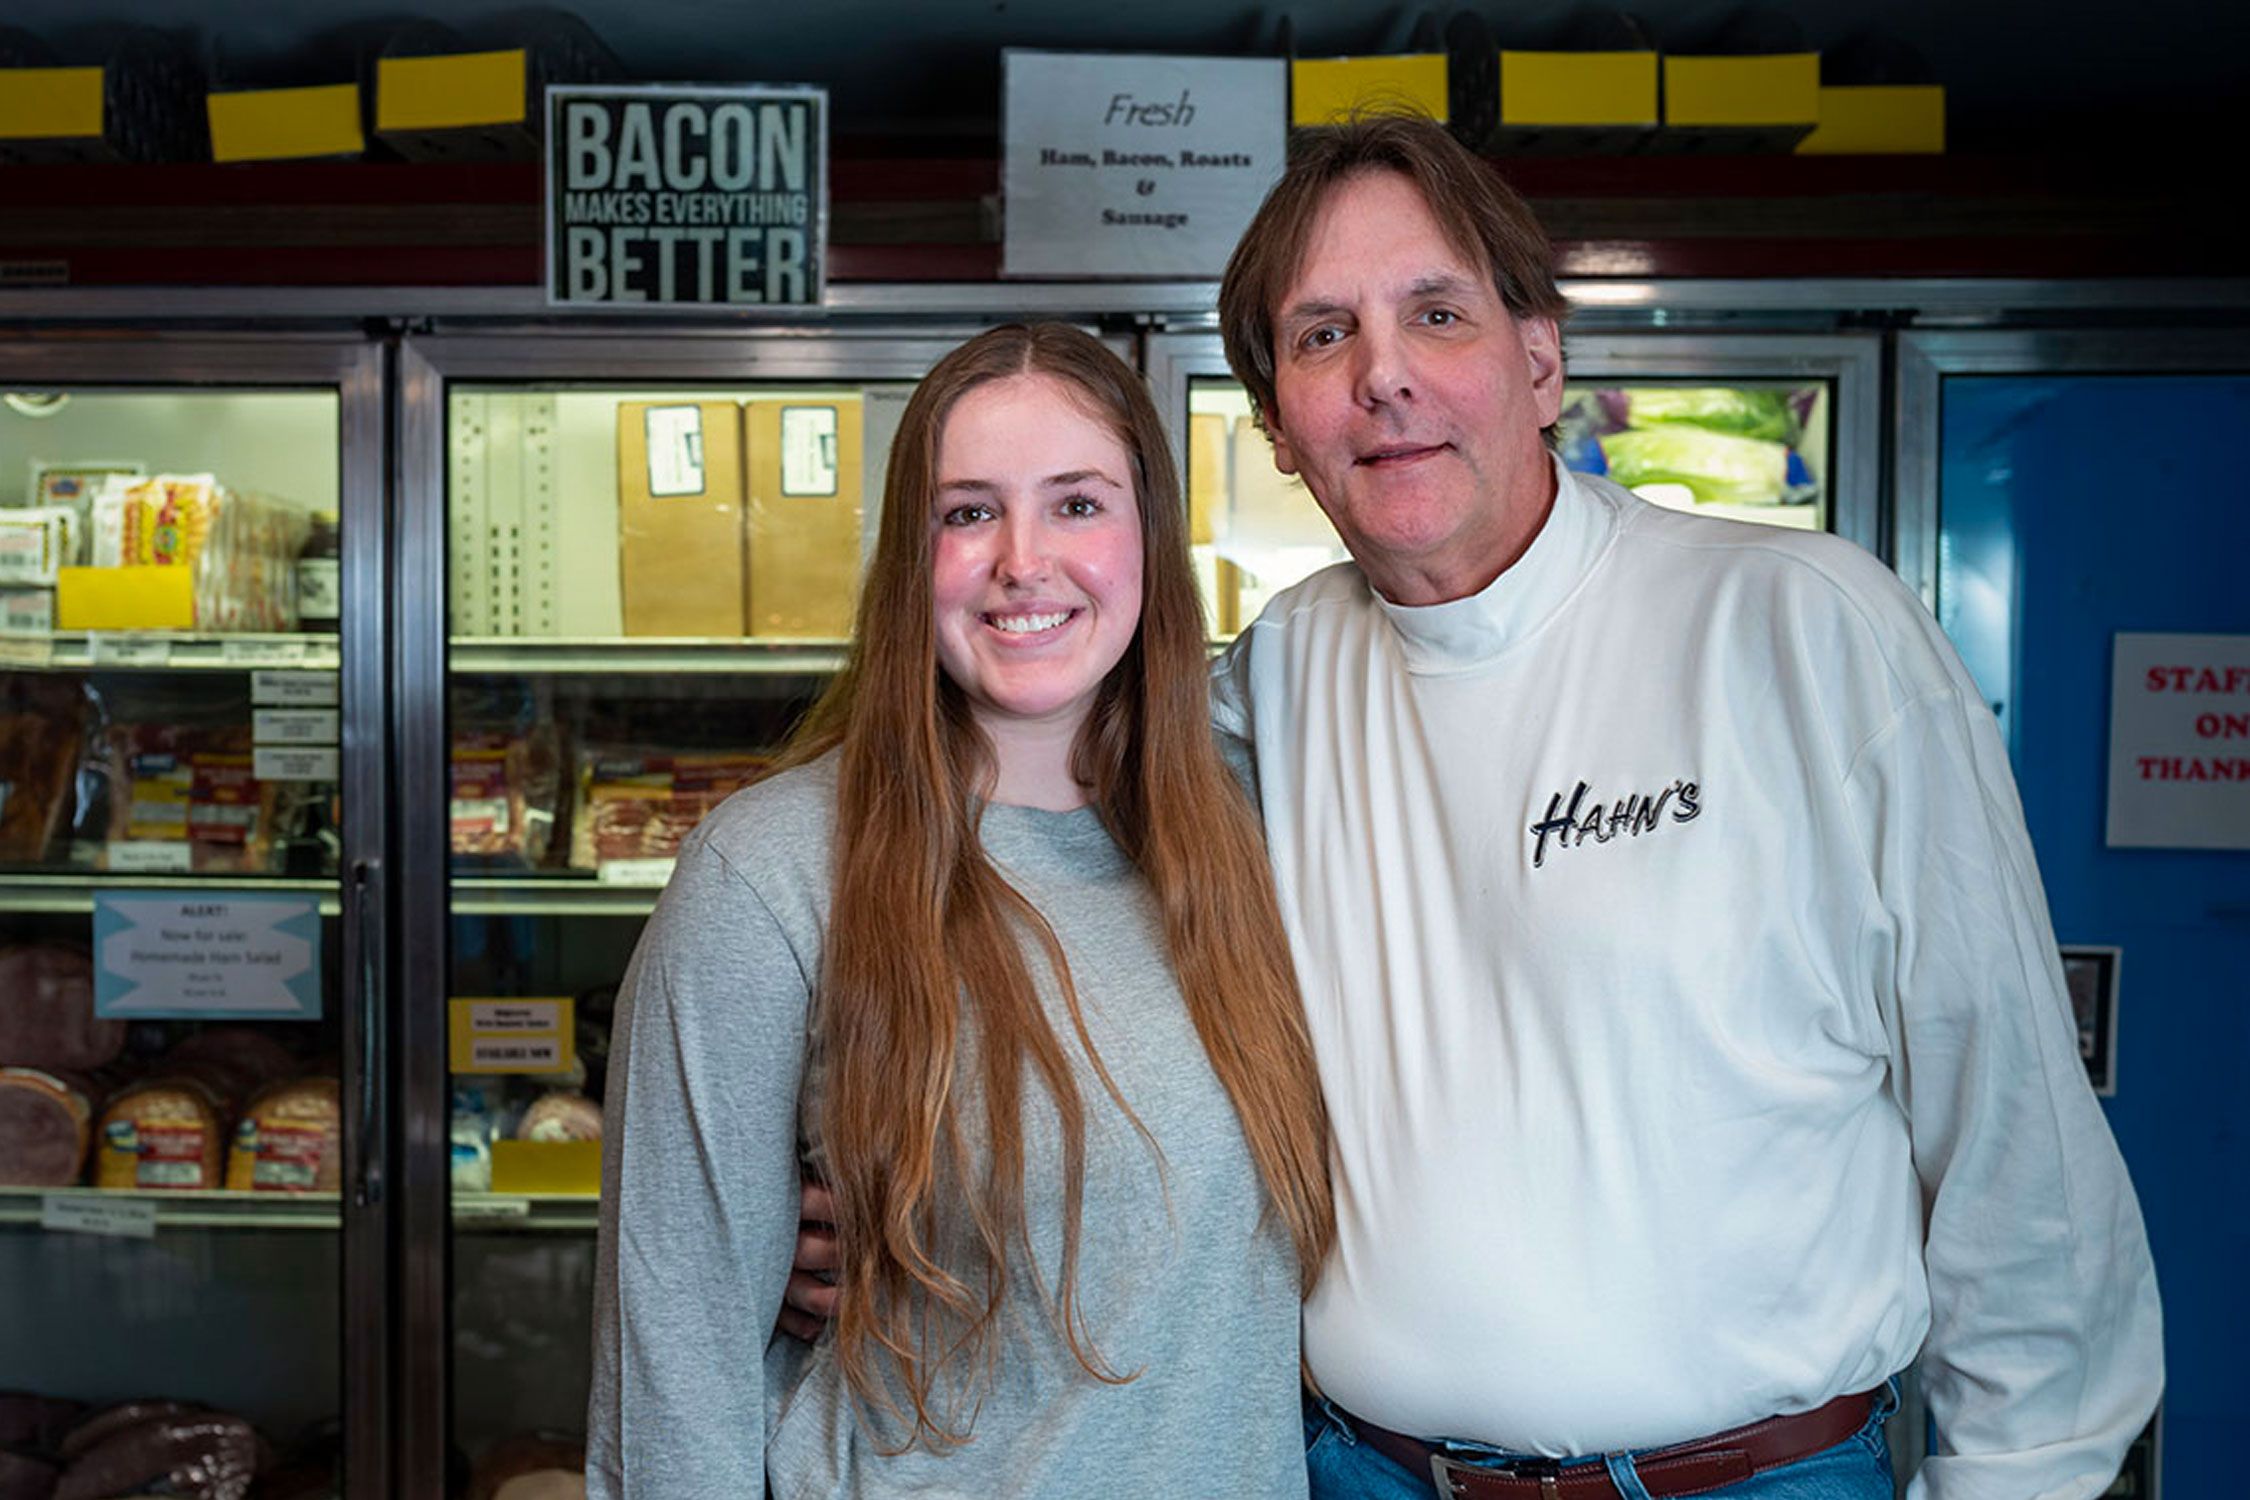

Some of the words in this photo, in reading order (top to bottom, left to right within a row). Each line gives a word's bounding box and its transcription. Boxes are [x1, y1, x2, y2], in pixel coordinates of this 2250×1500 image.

[1103, 88, 1196, 127] Fresh
[566, 102, 806, 191] BACON
[1040, 149, 1097, 168] Ham,
[1103, 149, 1175, 168] Bacon,
[1180, 150, 1252, 167] Roasts
[1135, 179, 1156, 196] &
[564, 192, 650, 223] MAKES
[655, 192, 807, 223] EVERYTHING
[1102, 209, 1189, 228] Sausage
[567, 226, 807, 304] BETTER
[2145, 665, 2250, 693] STAF
[180, 904, 229, 917] ALERT!
[160, 929, 191, 942] Now
[194, 929, 214, 942] for
[130, 950, 206, 964] Homemade
[209, 950, 242, 964] Ham
[245, 950, 282, 965] Salad
